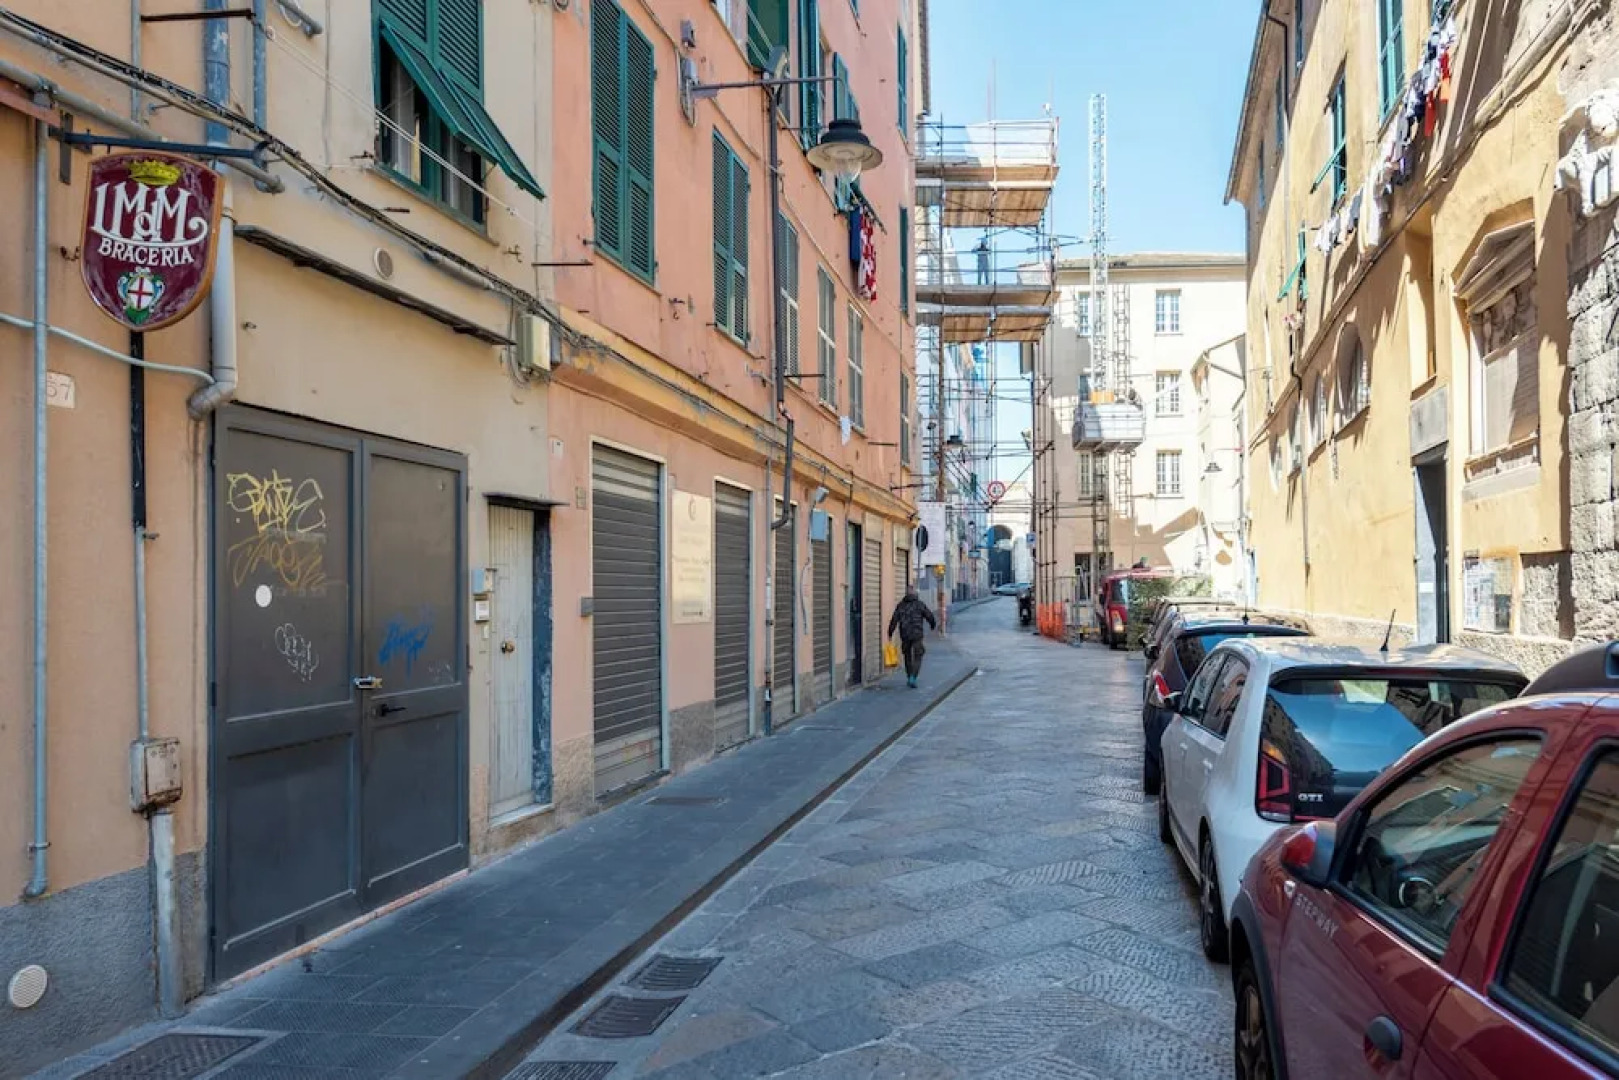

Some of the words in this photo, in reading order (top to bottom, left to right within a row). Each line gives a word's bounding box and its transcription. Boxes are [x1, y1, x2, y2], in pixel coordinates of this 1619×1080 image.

[98, 237, 195, 267] BRACERIA
[1297, 792, 1324, 803] GTI
[1295, 893, 1339, 938] STEPWAY
